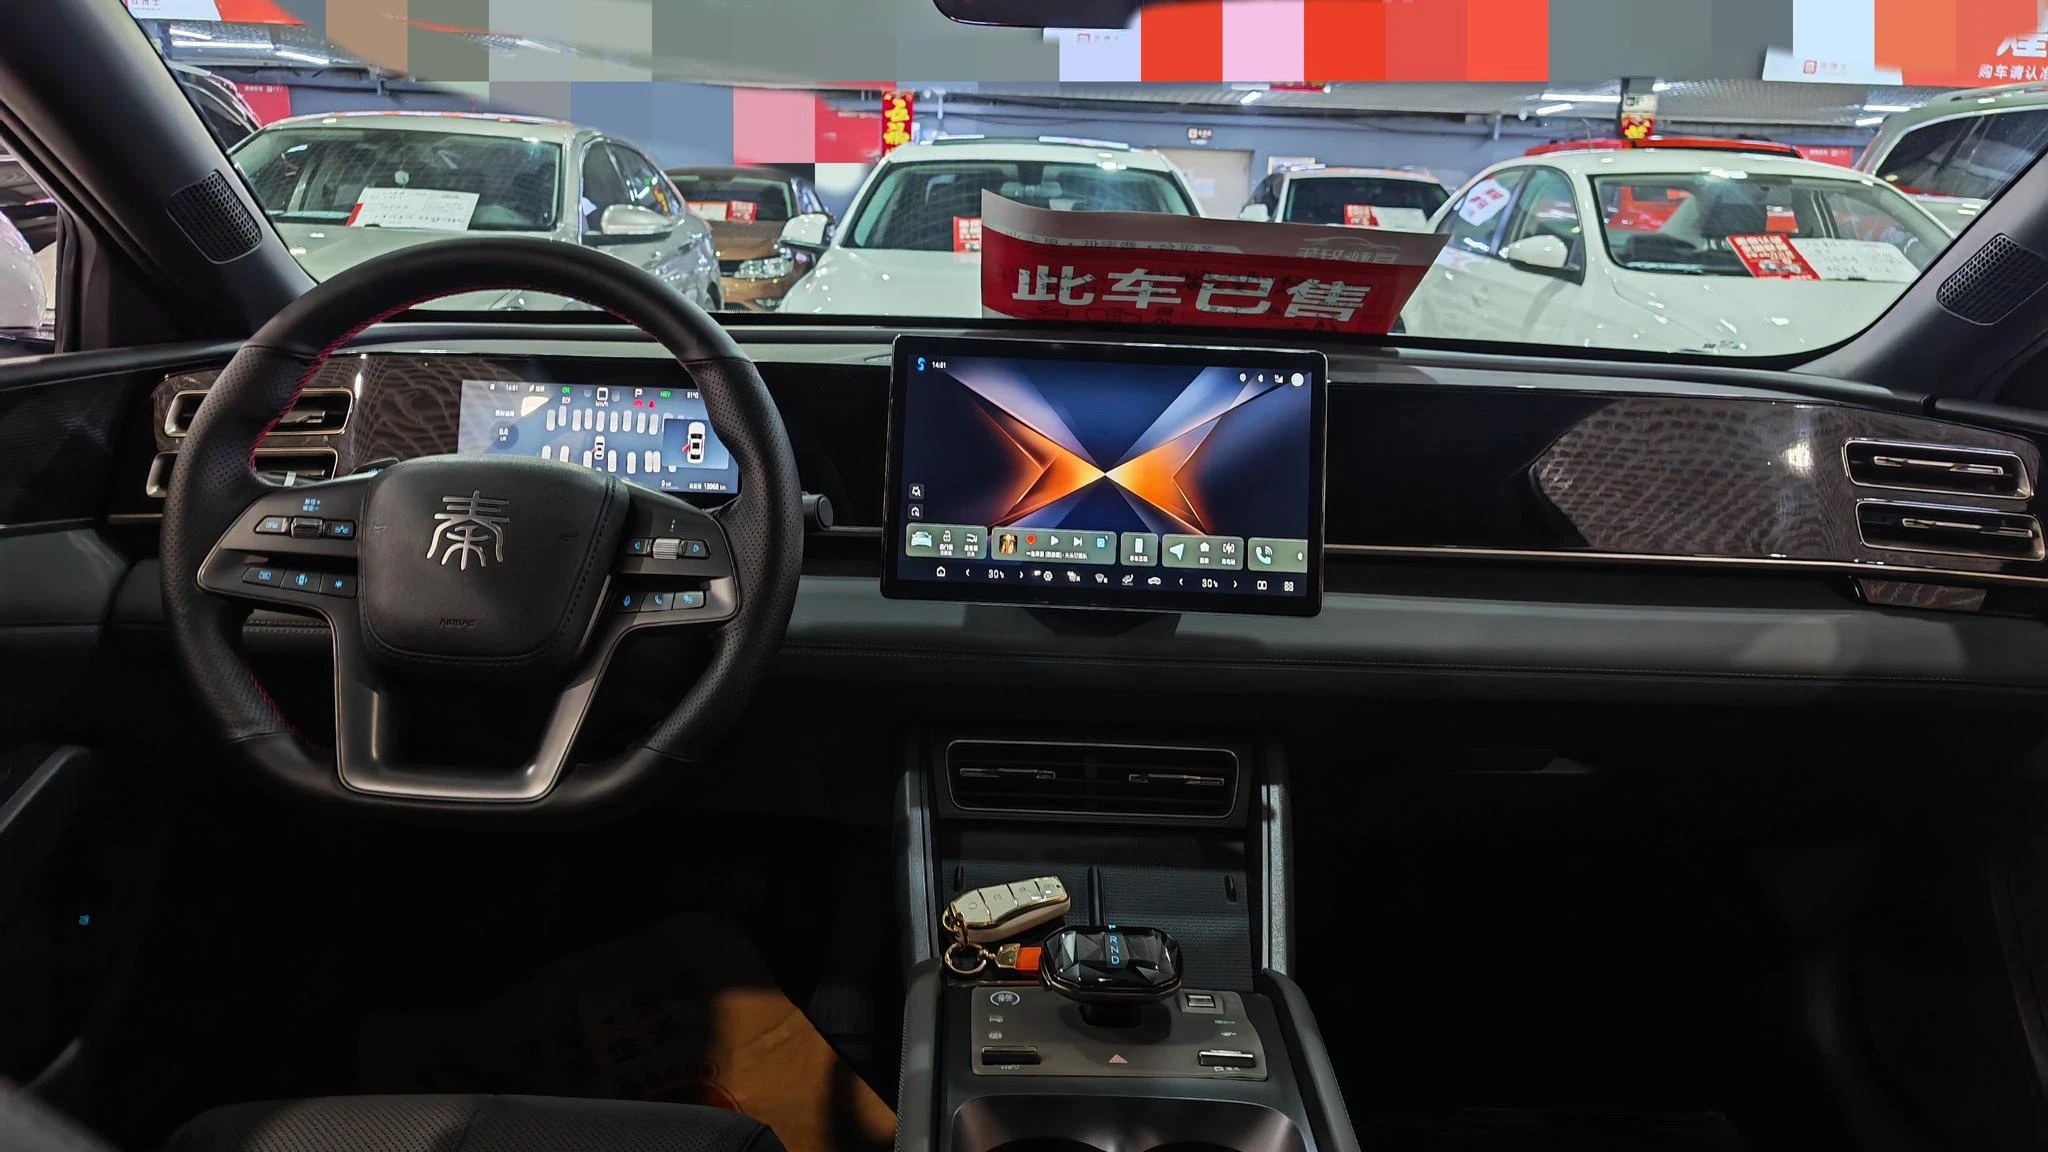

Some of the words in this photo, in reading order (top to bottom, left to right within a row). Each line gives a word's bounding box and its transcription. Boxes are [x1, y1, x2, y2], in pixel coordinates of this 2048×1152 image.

[1011, 264, 1373, 322] 此车已售
[635, 388, 643, 397] P
[426, 490, 511, 571] 秦
